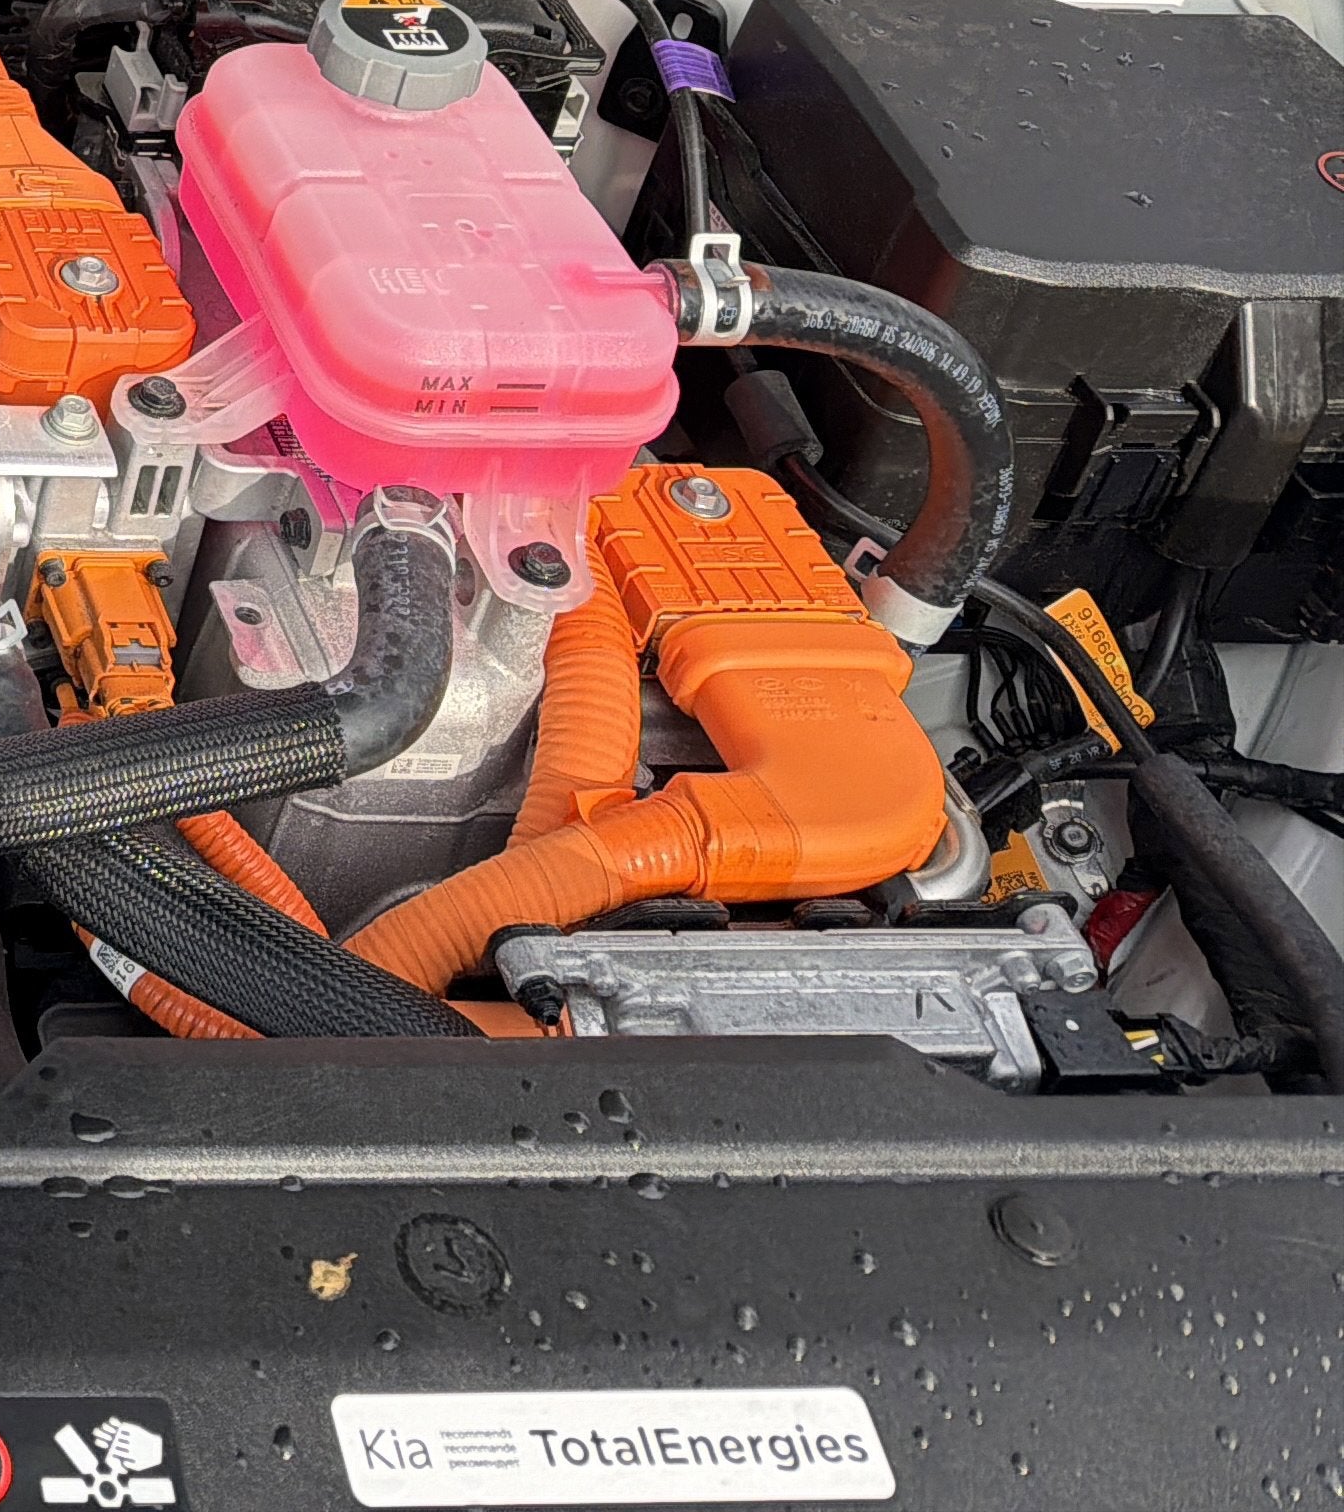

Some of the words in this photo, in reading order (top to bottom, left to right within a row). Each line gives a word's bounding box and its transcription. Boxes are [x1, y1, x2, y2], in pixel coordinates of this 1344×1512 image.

[421, 376, 473, 391] MAX
[415, 399, 467, 414] MIN
[359, 1429, 432, 1470] Kia
[529, 1424, 871, 1471] TotalEnergies
